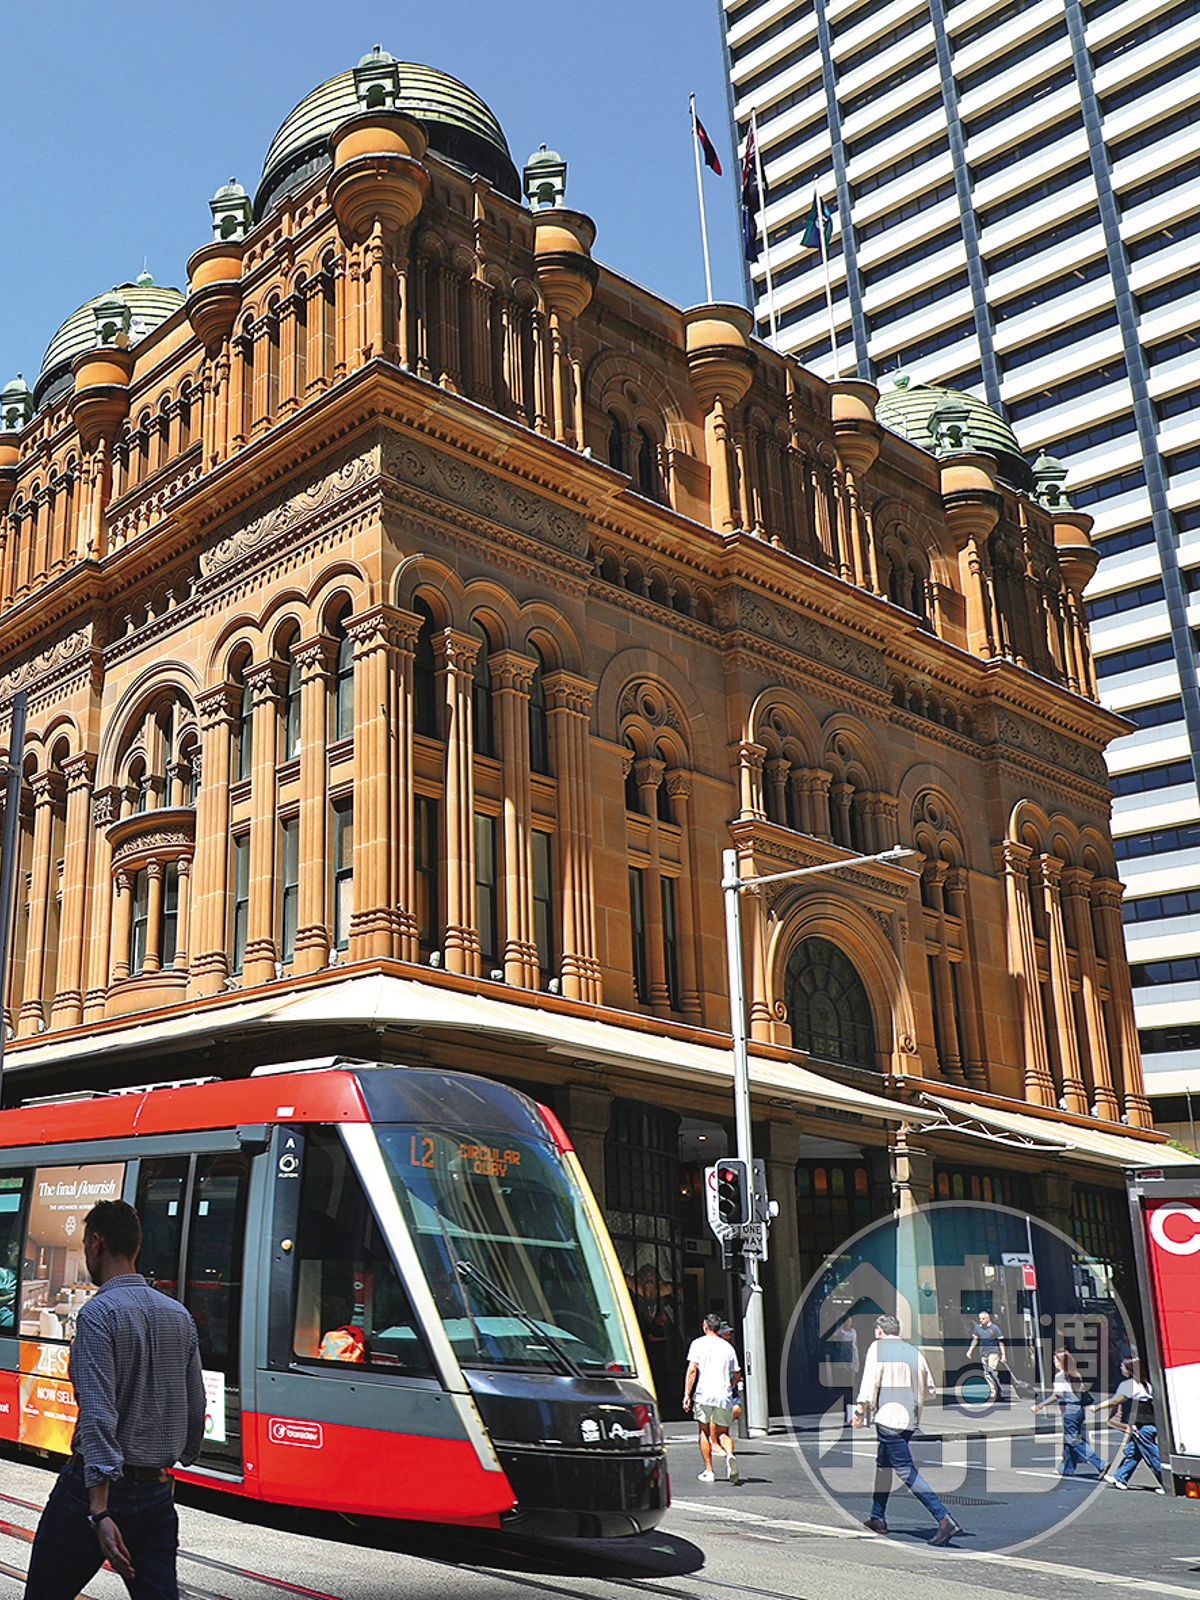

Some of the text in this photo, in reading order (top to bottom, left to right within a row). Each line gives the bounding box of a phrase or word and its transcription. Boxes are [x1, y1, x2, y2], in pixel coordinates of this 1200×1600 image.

[285, 1138, 295, 1148] A
[411, 1135, 521, 1168] L2 CIRCULAR
[39, 1182, 56, 1197] The
[56, 1180, 77, 1196] final
[75, 1179, 117, 1199] flourish
[743, 1225, 761, 1234] ONE
[37, 1346, 70, 1376] ZES
[36, 1386, 77, 1406] NOW SELL
